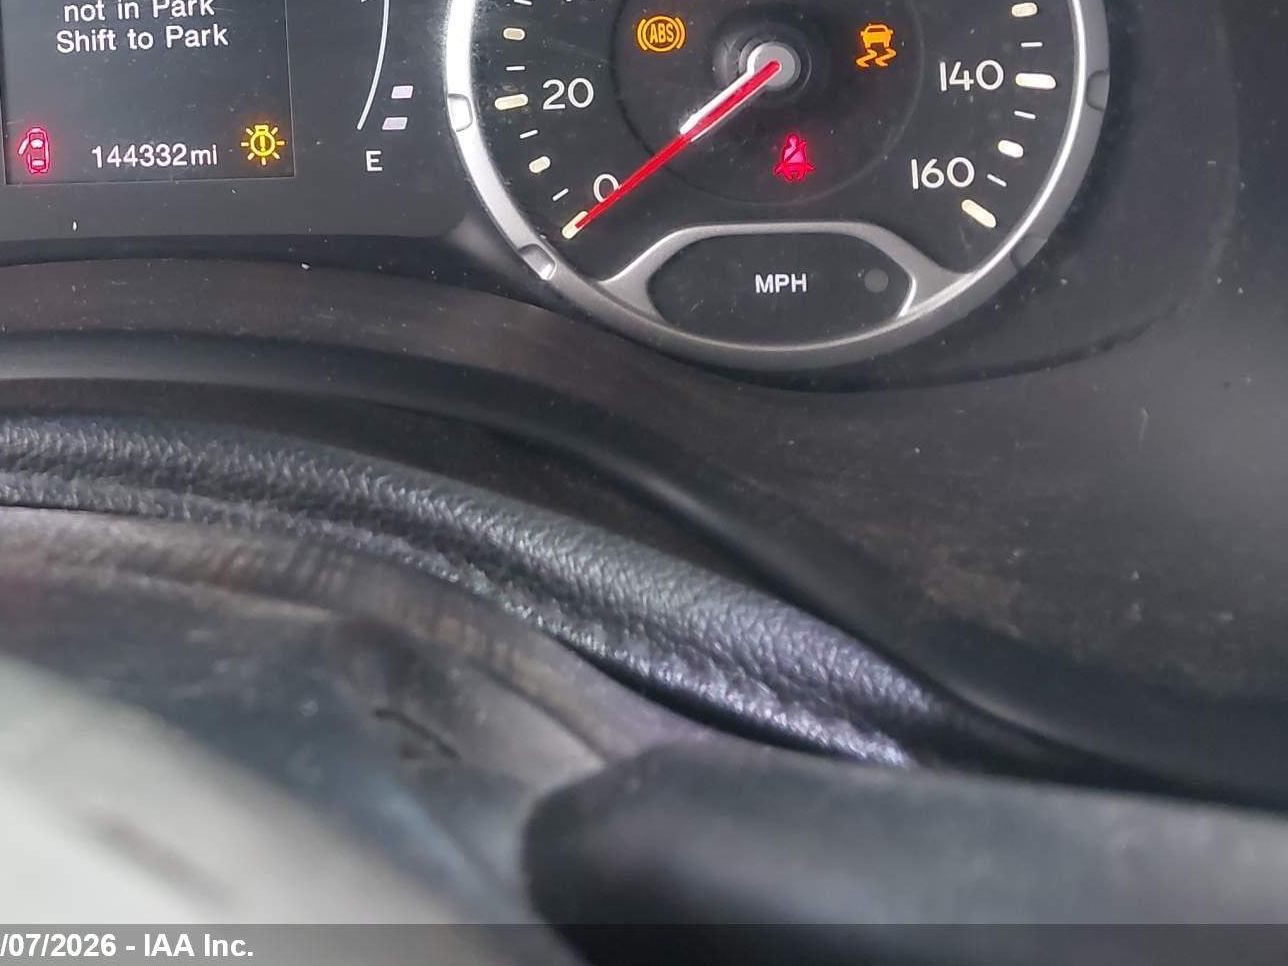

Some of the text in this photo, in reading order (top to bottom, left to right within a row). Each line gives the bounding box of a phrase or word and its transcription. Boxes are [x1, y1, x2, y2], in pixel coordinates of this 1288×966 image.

[65, 3, 105, 22] not
[57, 20, 228, 53] Shift to Park
[649, 23, 674, 43] ABS
[940, 60, 1003, 91] 140
[543, 78, 593, 109] 20
[366, 151, 382, 171] E
[912, 157, 974, 189] 160
[592, 173, 620, 203] 0
[756, 274, 806, 293] MPH
